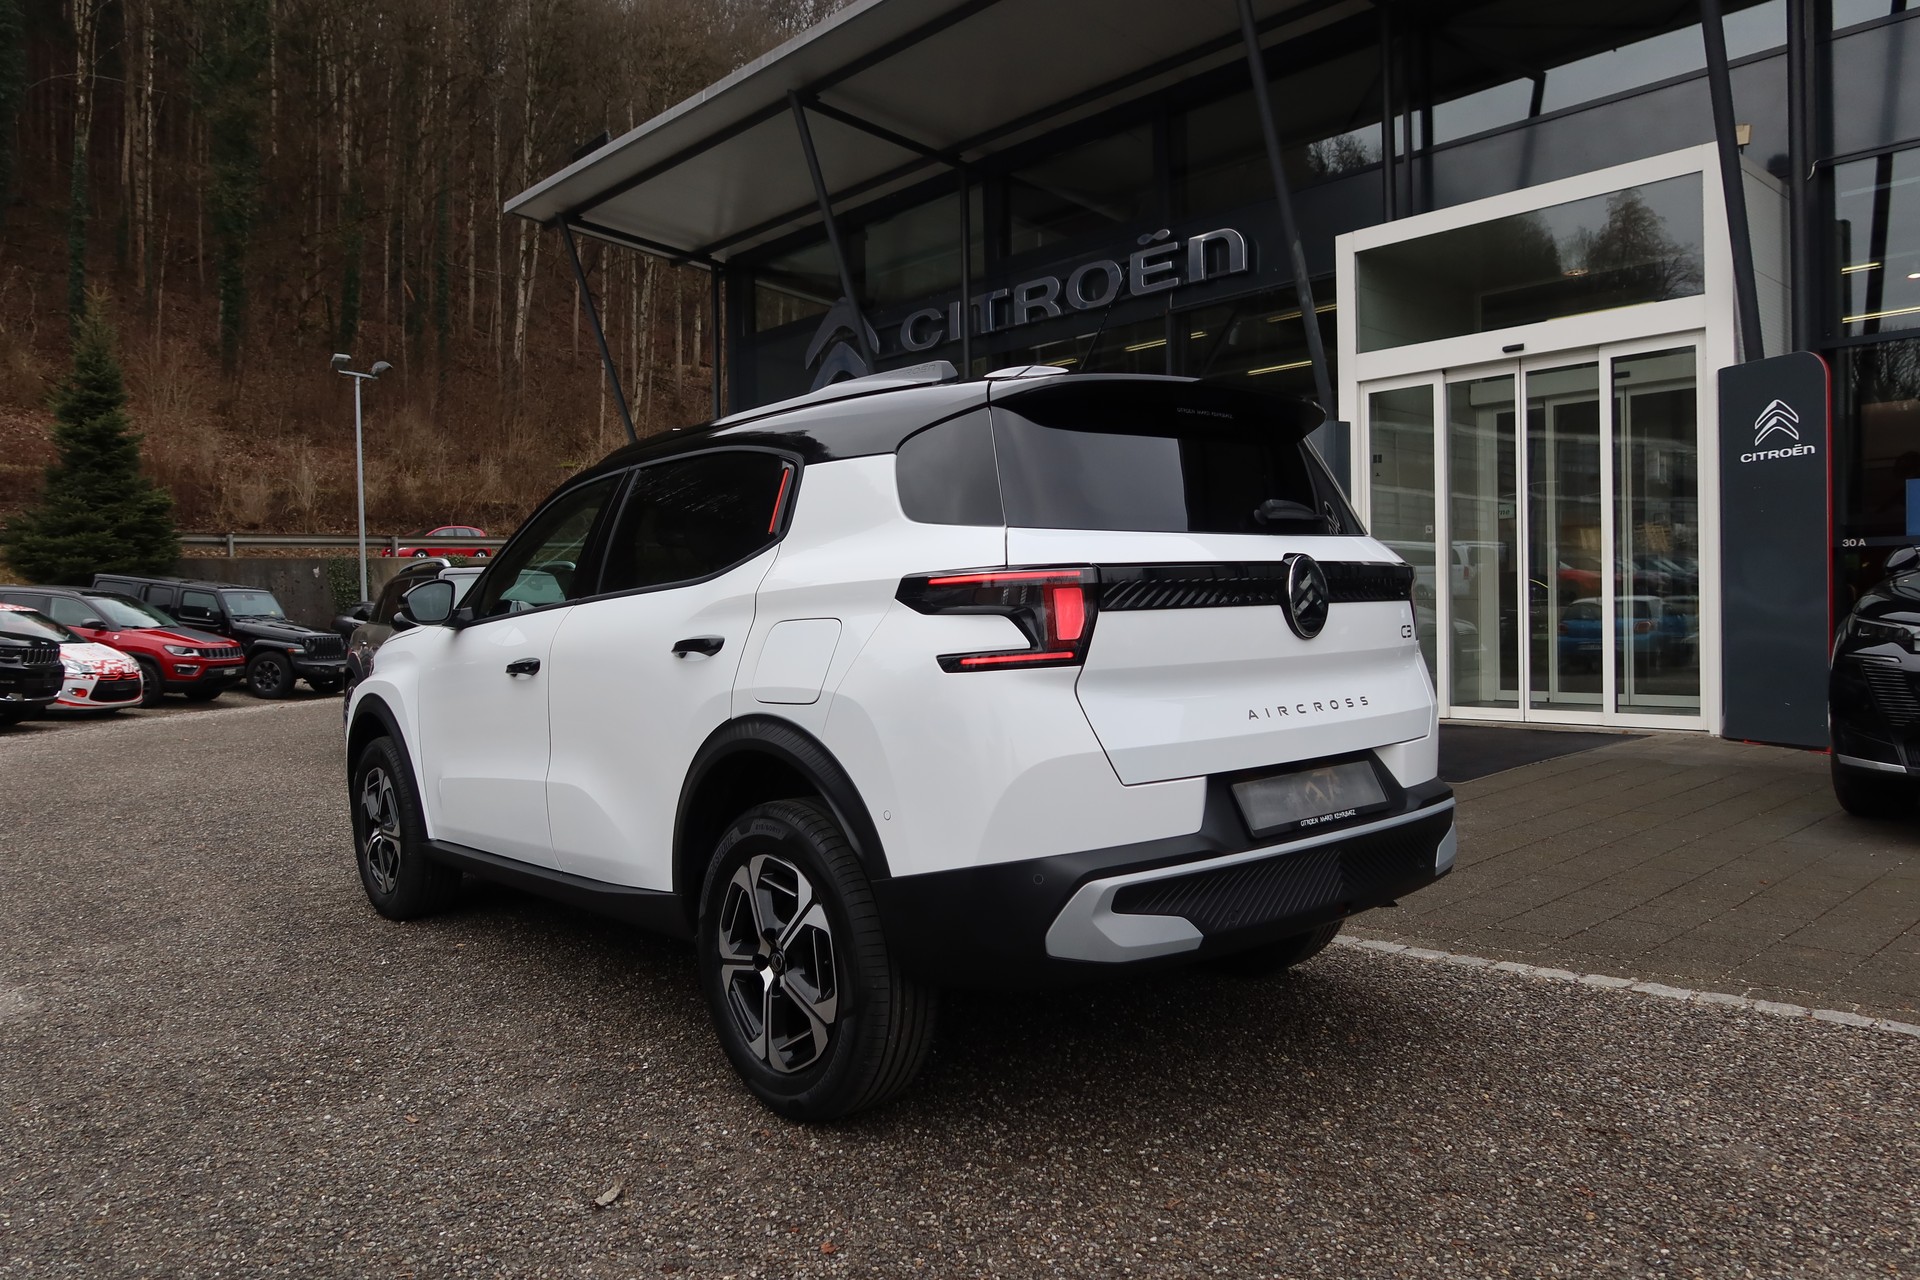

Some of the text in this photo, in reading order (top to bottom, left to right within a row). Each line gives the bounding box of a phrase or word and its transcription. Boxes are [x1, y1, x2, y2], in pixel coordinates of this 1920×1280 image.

[1842, 538, 1866, 547] 30 A
[1400, 624, 1412, 638] C3
[1247, 696, 1369, 720] AIRCROSS
